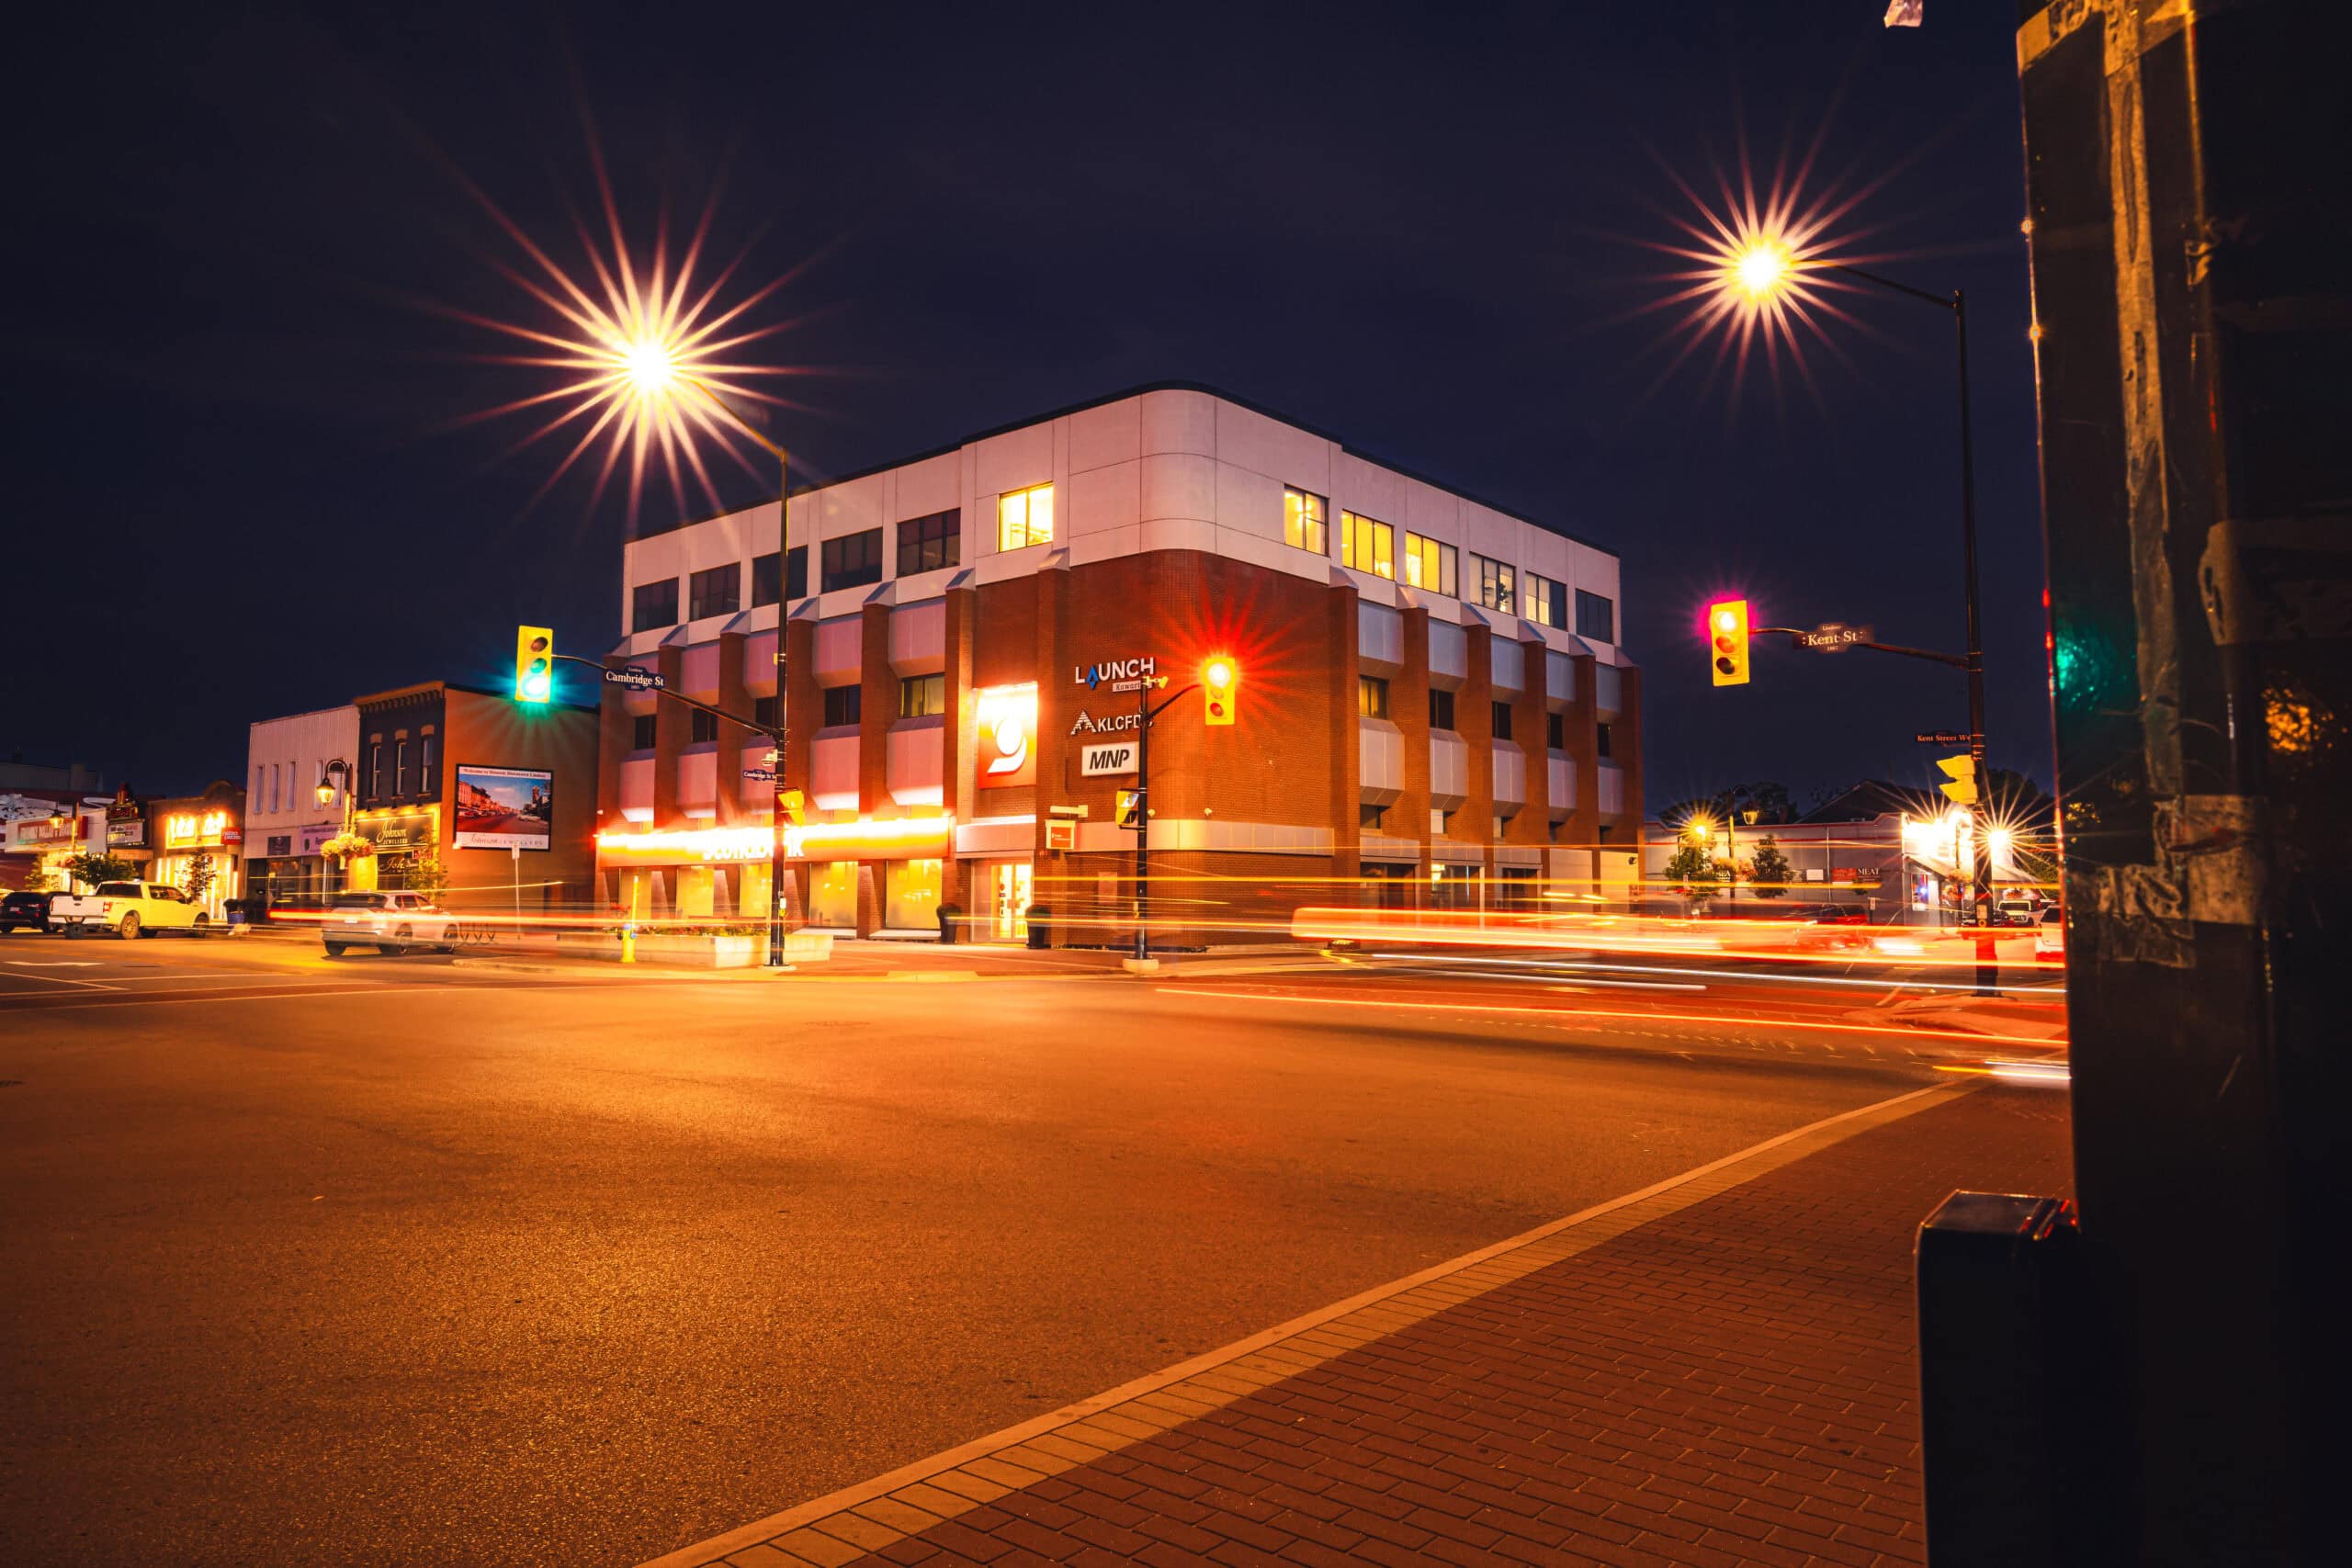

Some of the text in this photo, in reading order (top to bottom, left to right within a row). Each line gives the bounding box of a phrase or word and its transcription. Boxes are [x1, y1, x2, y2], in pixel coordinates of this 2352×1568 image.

[1807, 630, 1858, 646] Kent St
[605, 671, 652, 687] Cambridge
[654, 676, 663, 686] St
[1075, 657, 1154, 691] LAUNCH
[1115, 682, 1151, 692] Kawart
[1098, 715, 1152, 732] KLCFD
[1917, 734, 1934, 742] Kent
[1090, 749, 1129, 770] MNP
[376, 820, 408, 843] Johnson
[1858, 867, 1879, 876] MEAT
